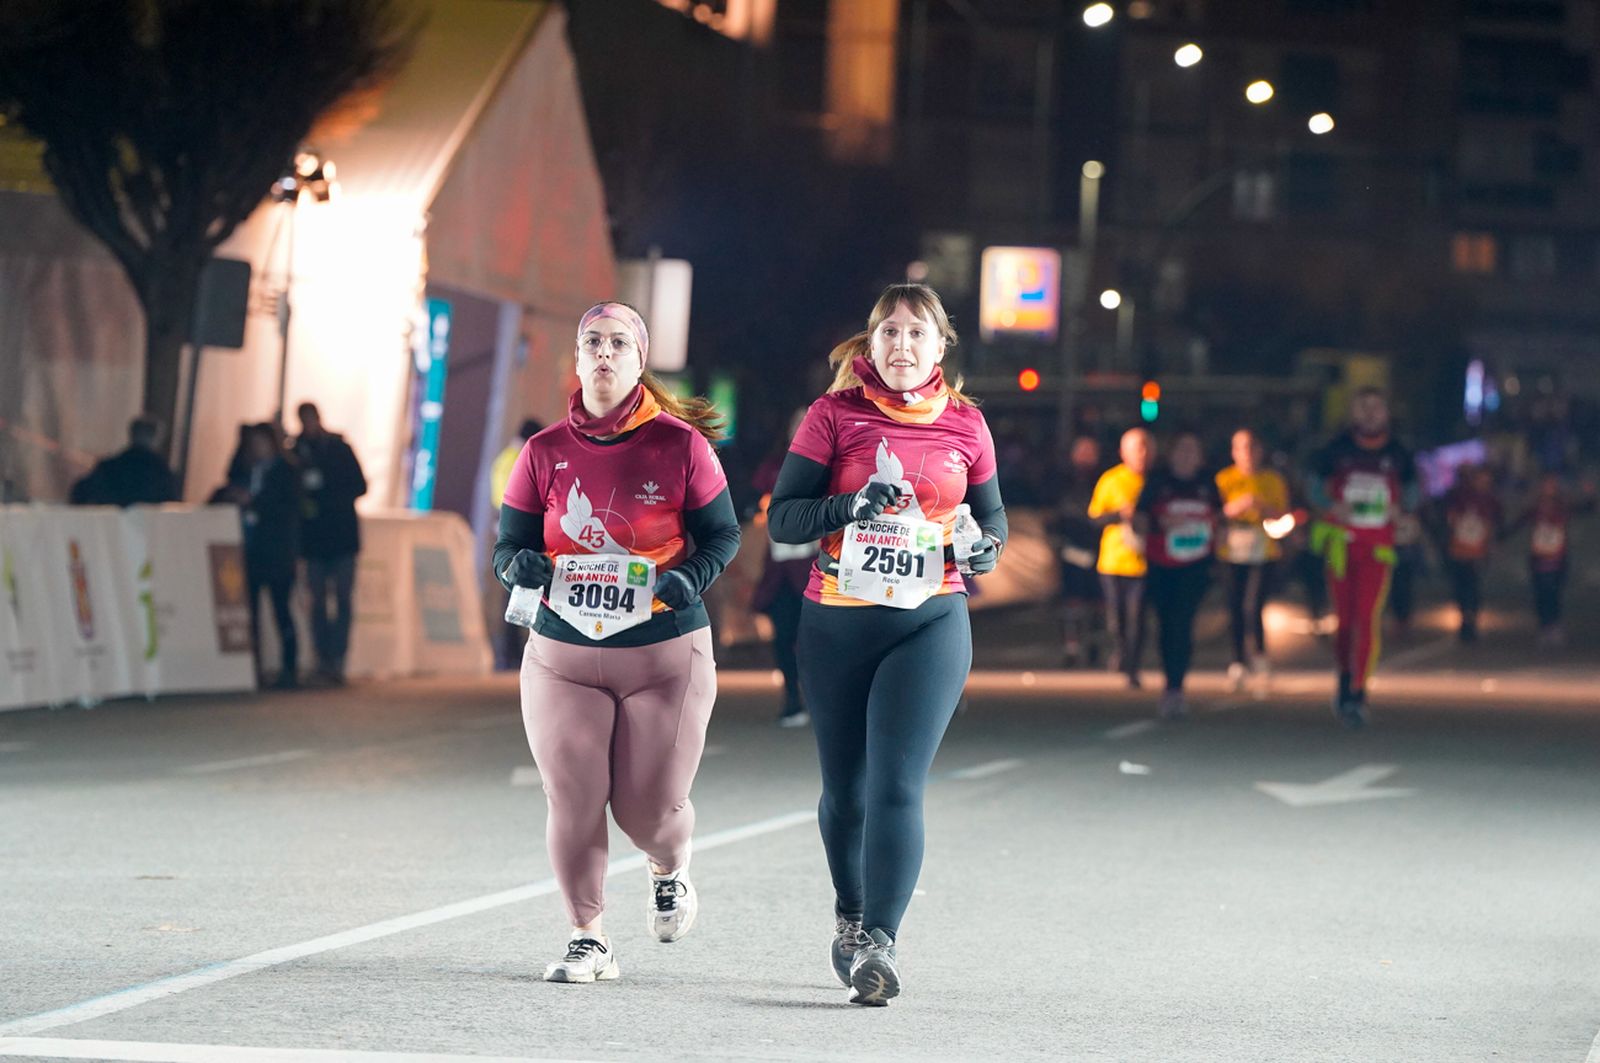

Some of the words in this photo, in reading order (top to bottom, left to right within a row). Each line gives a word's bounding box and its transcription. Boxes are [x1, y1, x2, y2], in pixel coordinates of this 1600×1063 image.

[869, 522, 899, 535] NOCHE
[900, 526, 911, 536] DE
[578, 524, 606, 549] 43
[856, 533, 876, 544] SAN
[577, 563, 607, 573] NOCHE
[607, 563, 620, 573] DE
[861, 545, 925, 578] 2591
[565, 573, 583, 582] SAN
[568, 583, 636, 614] 3094
